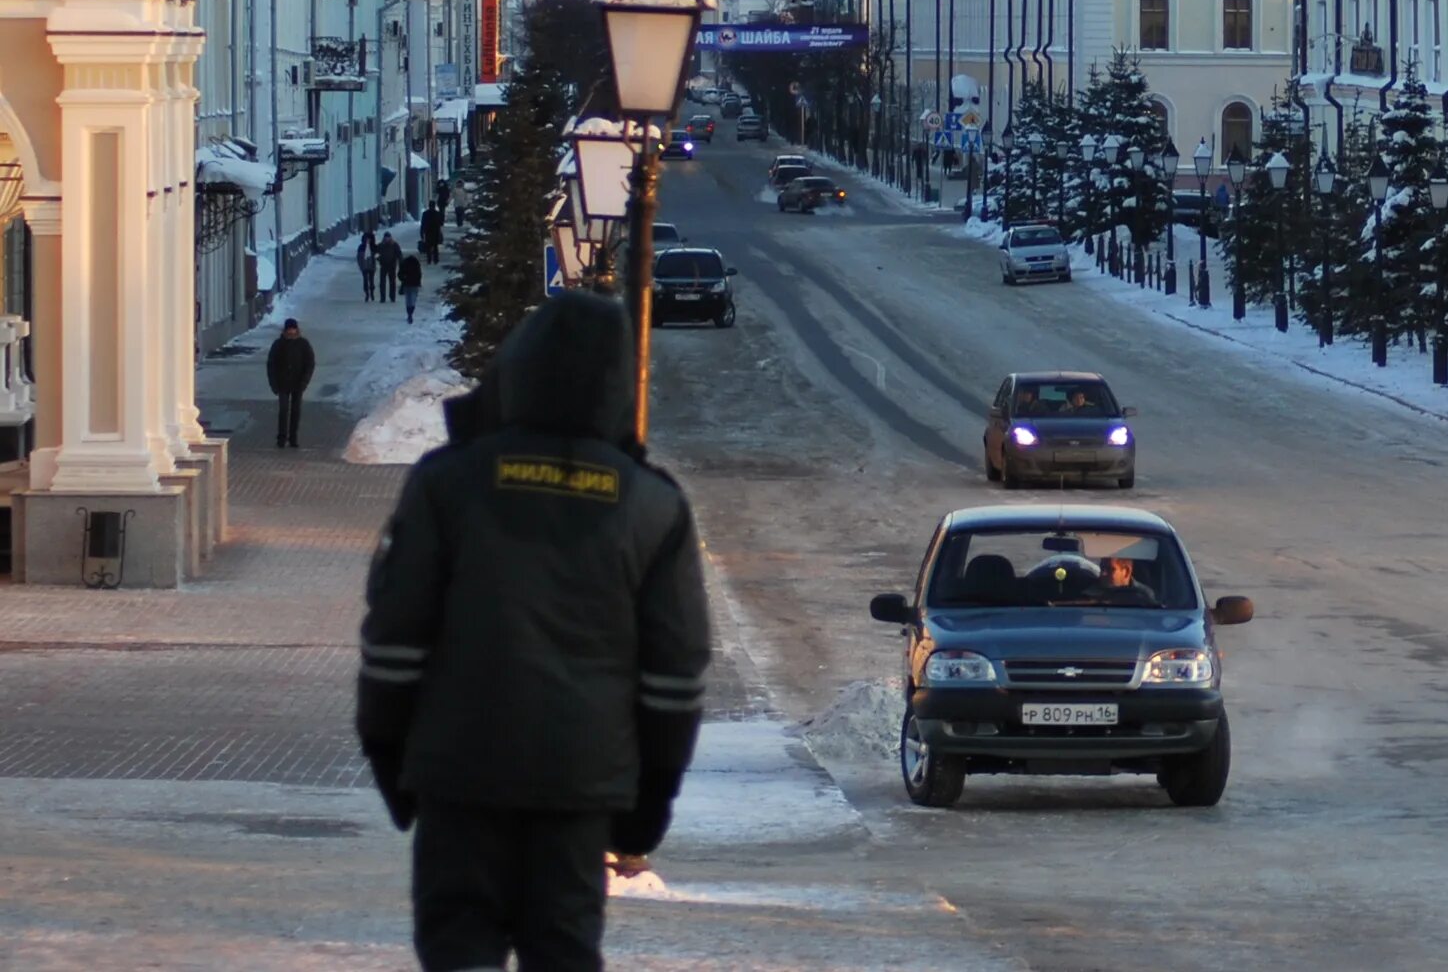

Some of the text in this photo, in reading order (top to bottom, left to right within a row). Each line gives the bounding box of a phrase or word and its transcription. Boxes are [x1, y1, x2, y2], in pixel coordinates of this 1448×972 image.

[740, 28, 791, 44] ШАЙБА
[463, 3, 473, 97] ИНТЕХБАНК
[929, 117, 940, 125] 40
[1042, 707, 1072, 723] 809
[1097, 707, 1112, 718] 16
